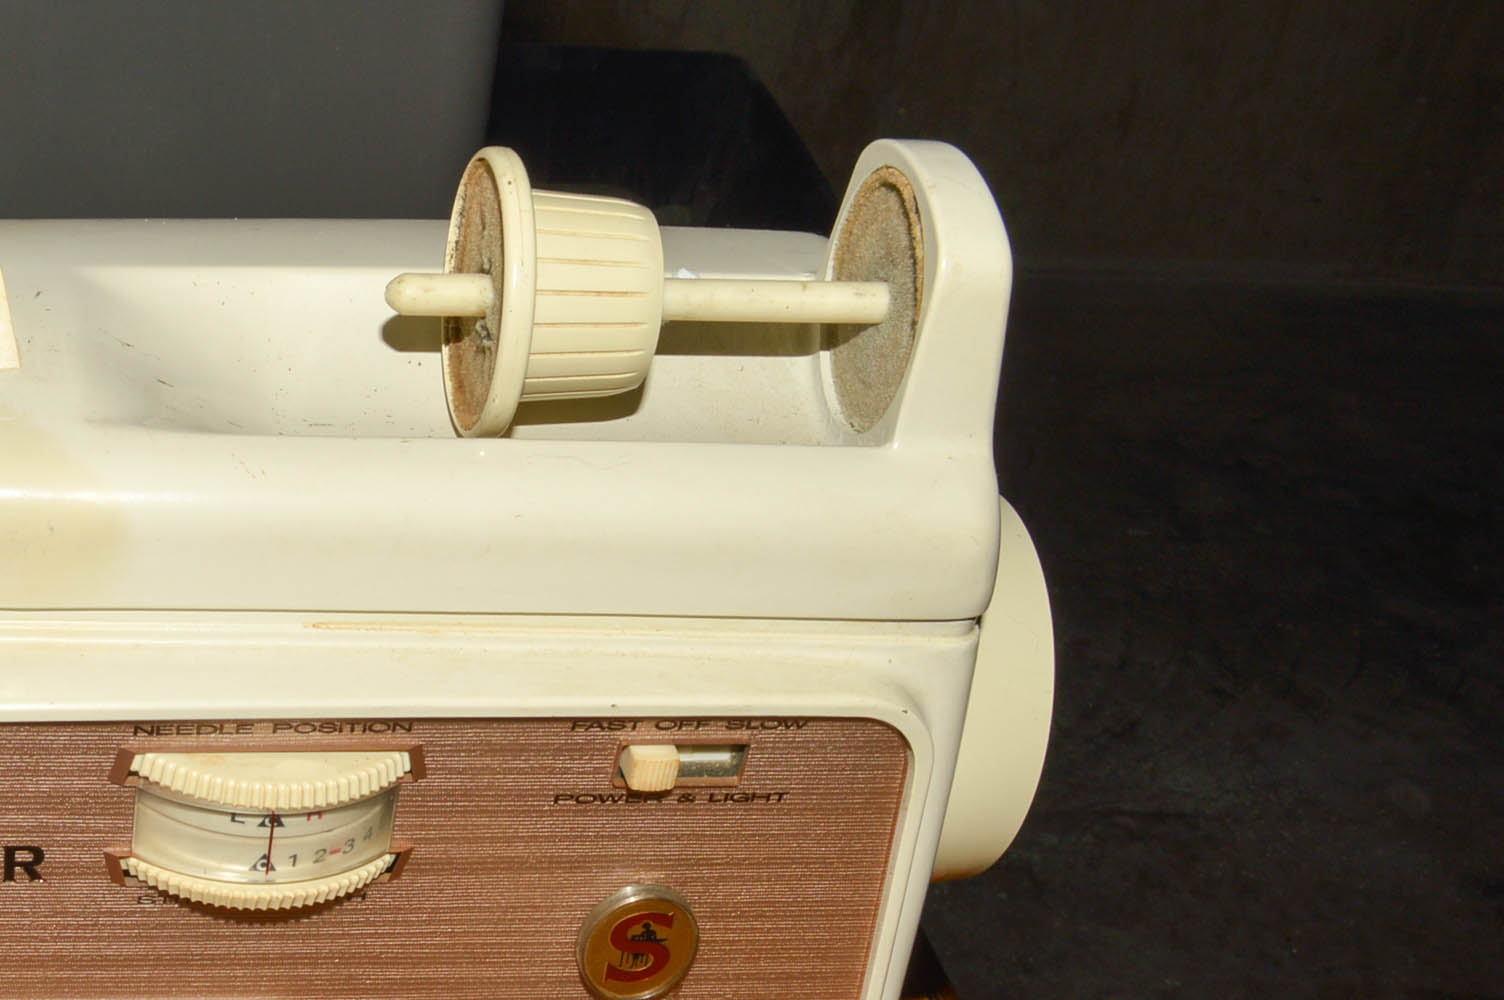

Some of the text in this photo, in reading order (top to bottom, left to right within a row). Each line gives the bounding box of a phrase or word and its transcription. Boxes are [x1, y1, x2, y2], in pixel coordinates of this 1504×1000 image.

[132, 720, 413, 736] NEEDLE POSITION
[570, 719, 808, 732] FAST OFF SLOW
[552, 792, 790, 805] POWER & LIGHT
[288, 854, 298, 867] 1
